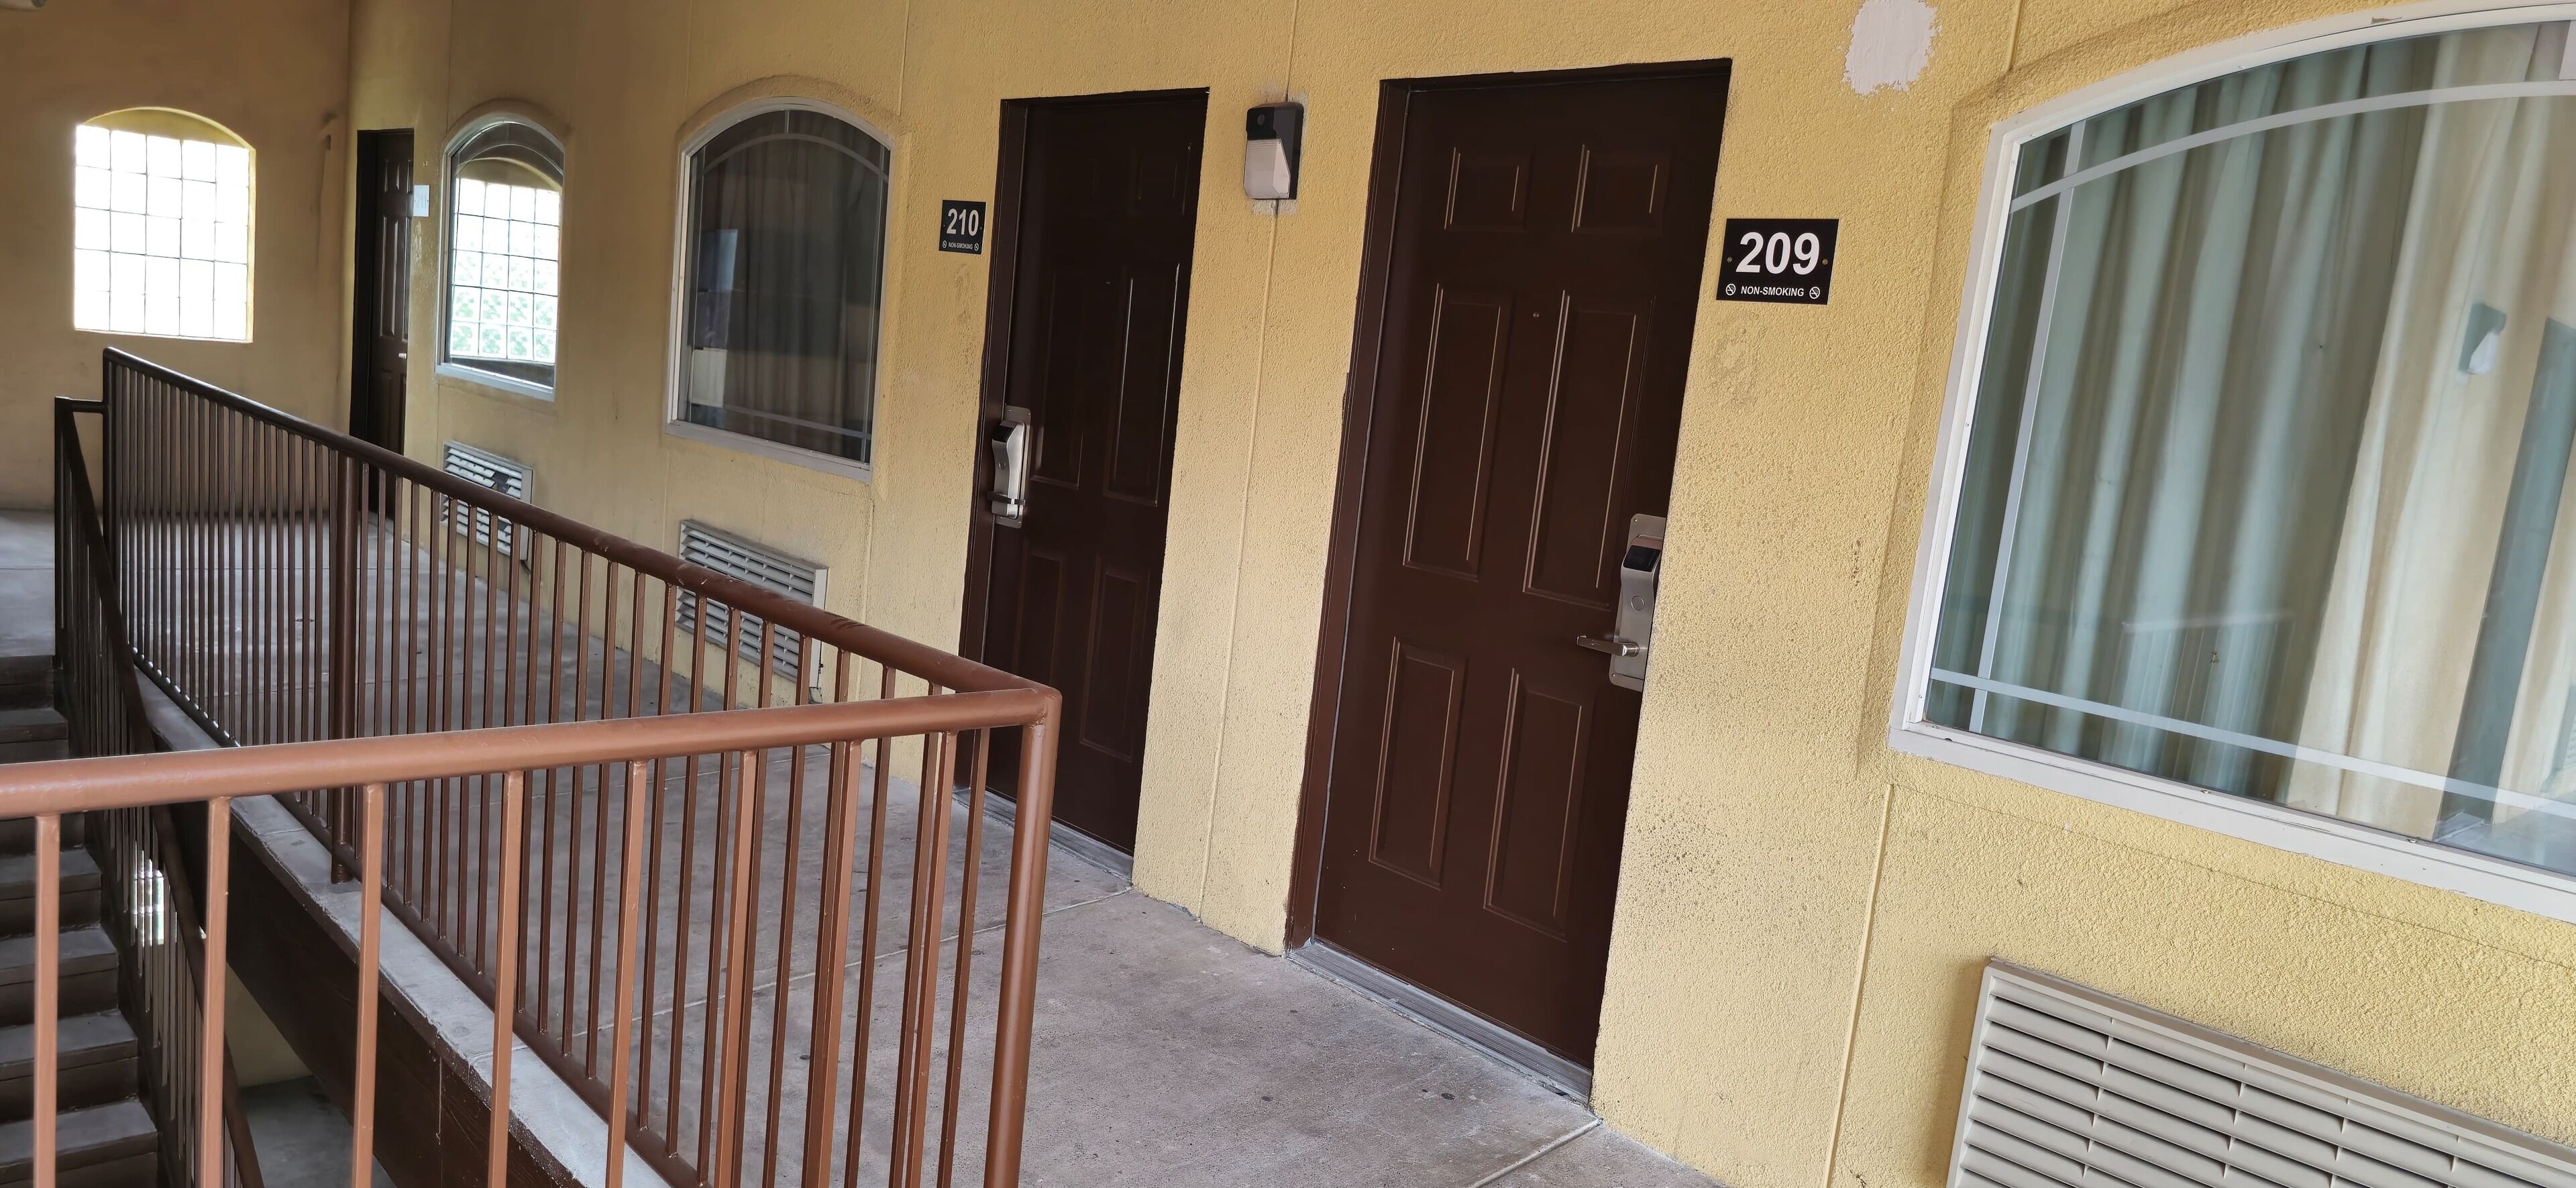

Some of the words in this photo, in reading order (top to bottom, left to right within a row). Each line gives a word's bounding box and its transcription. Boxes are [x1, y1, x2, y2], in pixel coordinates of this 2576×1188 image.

[947, 209, 979, 236] 210
[1735, 231, 1820, 275] 209
[1741, 286, 1805, 297] NON-SMOKING
